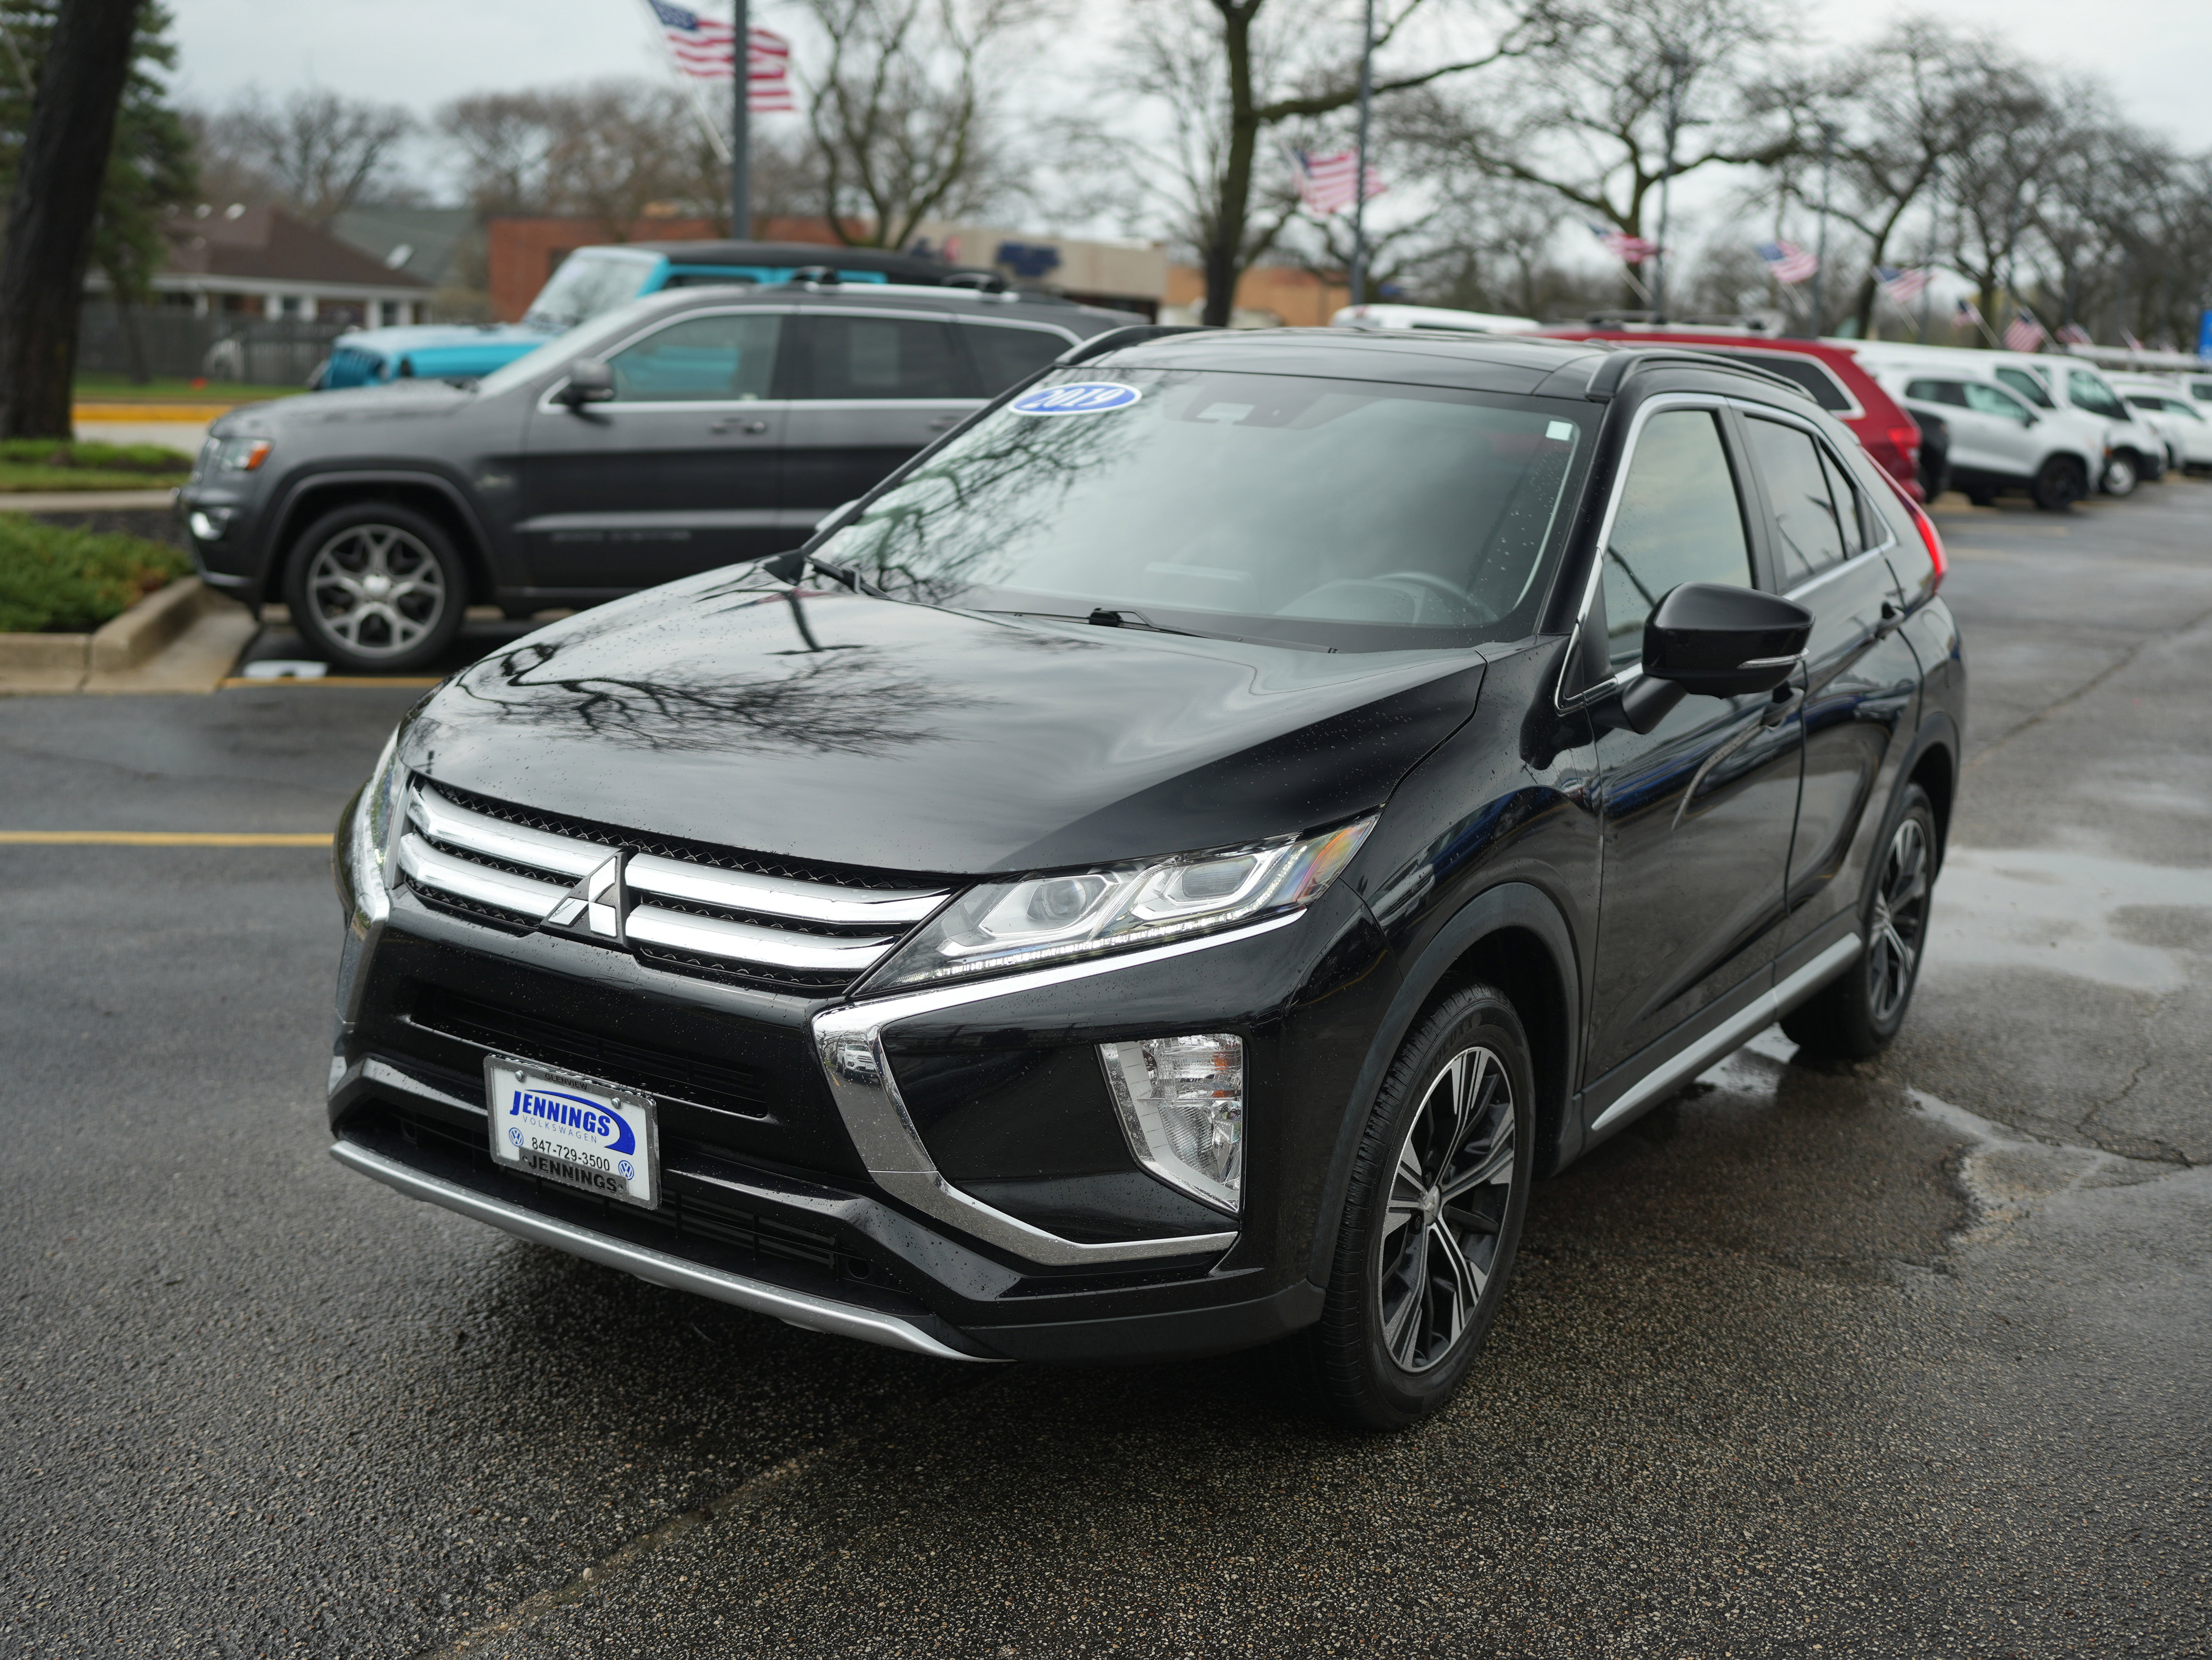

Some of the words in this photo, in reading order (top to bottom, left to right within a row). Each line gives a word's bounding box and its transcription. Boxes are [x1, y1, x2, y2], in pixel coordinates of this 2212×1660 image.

[1021, 388, 1125, 408] 2019
[545, 1073, 587, 1089] GLENVIEW
[510, 1091, 610, 1136] JENNINGS
[523, 1115, 597, 1143] VOLKSWAGEN
[532, 1137, 610, 1171] 847-729-3500
[528, 1155, 617, 1193] JENNINGS
